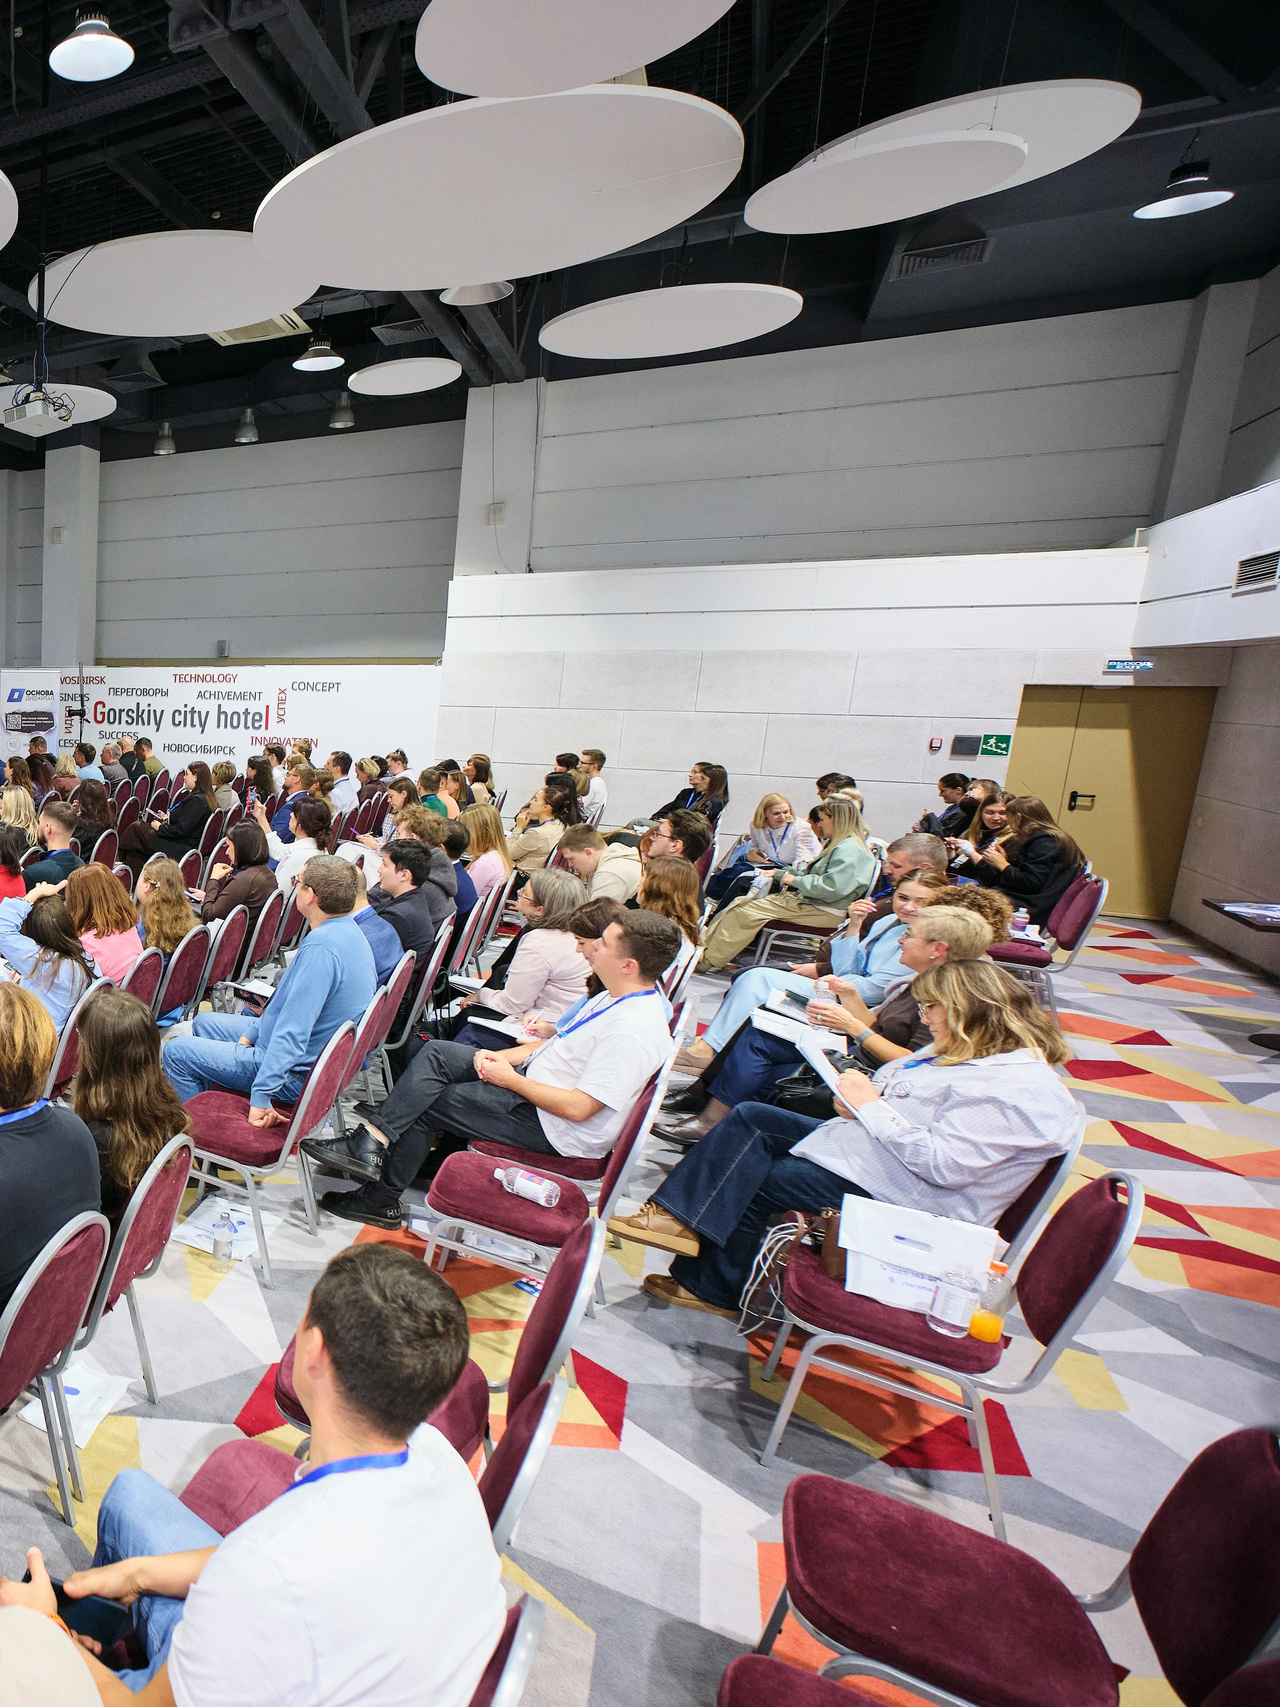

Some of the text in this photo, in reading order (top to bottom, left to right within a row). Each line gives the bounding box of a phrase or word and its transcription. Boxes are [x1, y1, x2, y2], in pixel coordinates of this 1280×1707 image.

[173, 674, 238, 683] TECHNOLOGY
[108, 687, 168, 698] ПЕРЕГОВОРЫ
[292, 682, 342, 692] CONCEPT
[196, 690, 263, 701] ACHIVEMENT
[277, 688, 287, 724] УСПЕХ
[94, 701, 270, 734] Gorskiy city hotel
[163, 743, 236, 756] НОВОСИБИРСК
